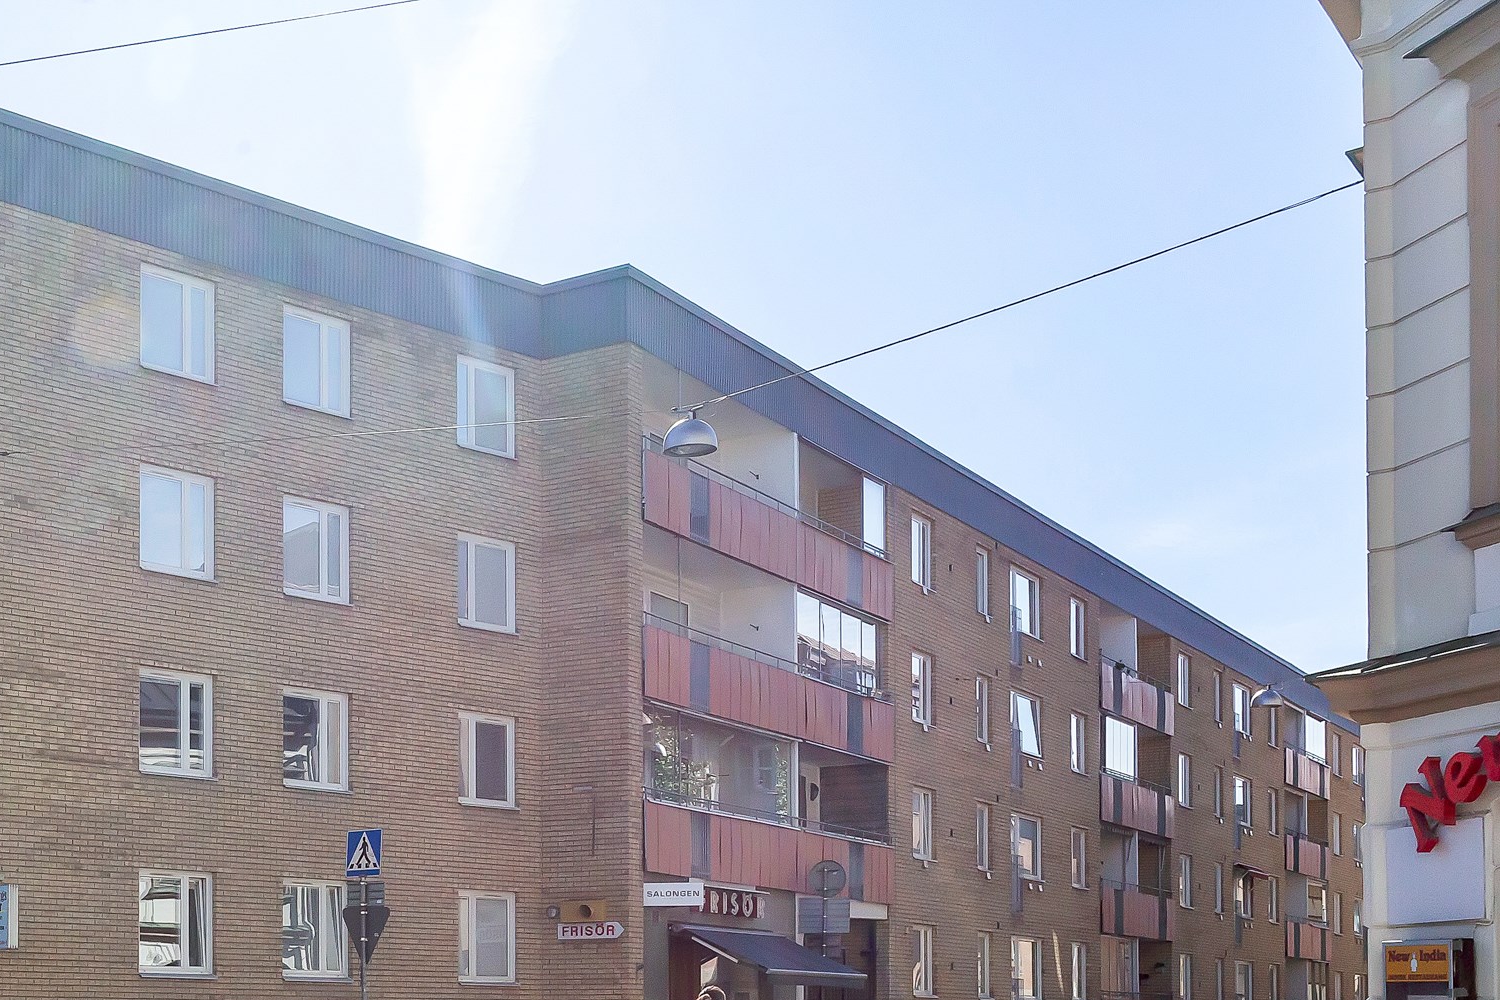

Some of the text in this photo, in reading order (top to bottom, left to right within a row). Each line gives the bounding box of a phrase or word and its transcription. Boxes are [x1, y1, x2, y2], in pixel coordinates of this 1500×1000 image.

[646, 890, 700, 898] SALONGEN
[562, 923, 615, 937] FRISÖR
[1388, 949, 1446, 962] New India
